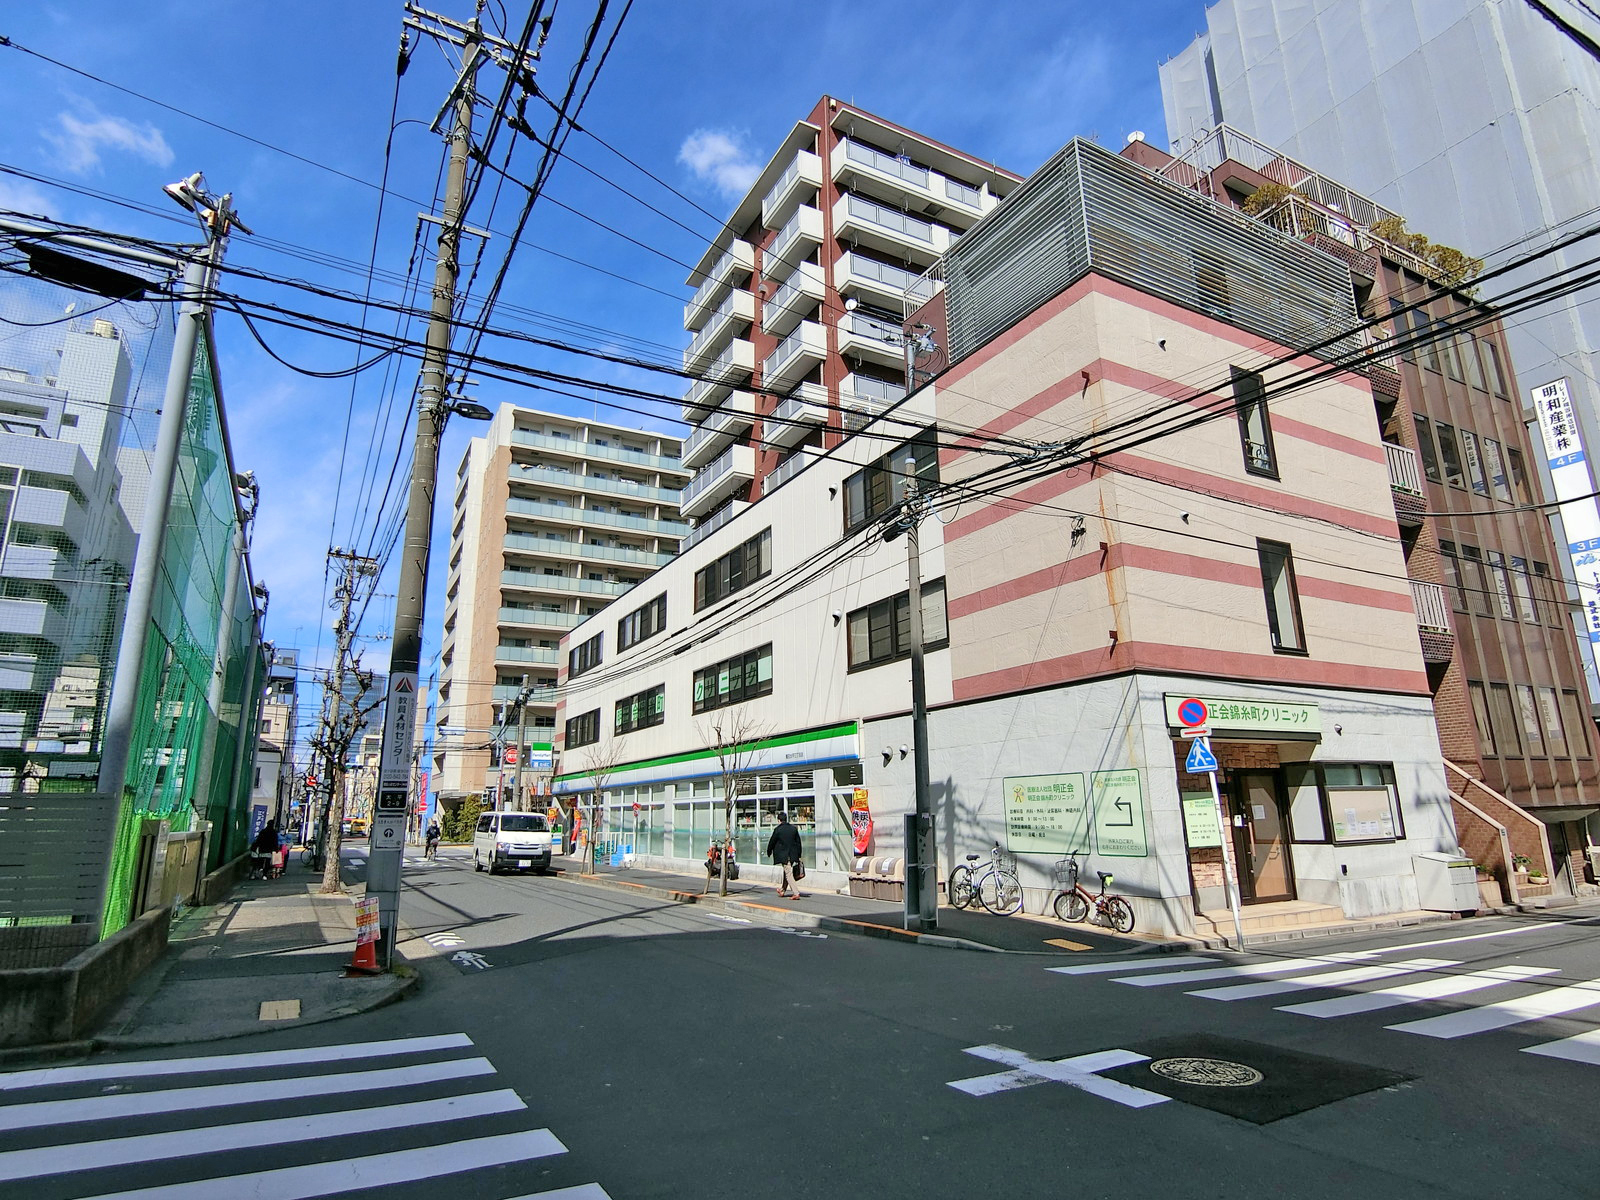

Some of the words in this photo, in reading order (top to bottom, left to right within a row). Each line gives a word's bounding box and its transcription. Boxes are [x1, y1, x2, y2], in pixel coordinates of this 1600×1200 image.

[1556, 454, 1577, 466] 4F
[1577, 538, 1598, 551] 3F
[1207, 703, 1309, 723] 正会錦糸町クリニック
[393, 696, 408, 765] 教員人材センター
[1053, 783, 1074, 793] 明正会
